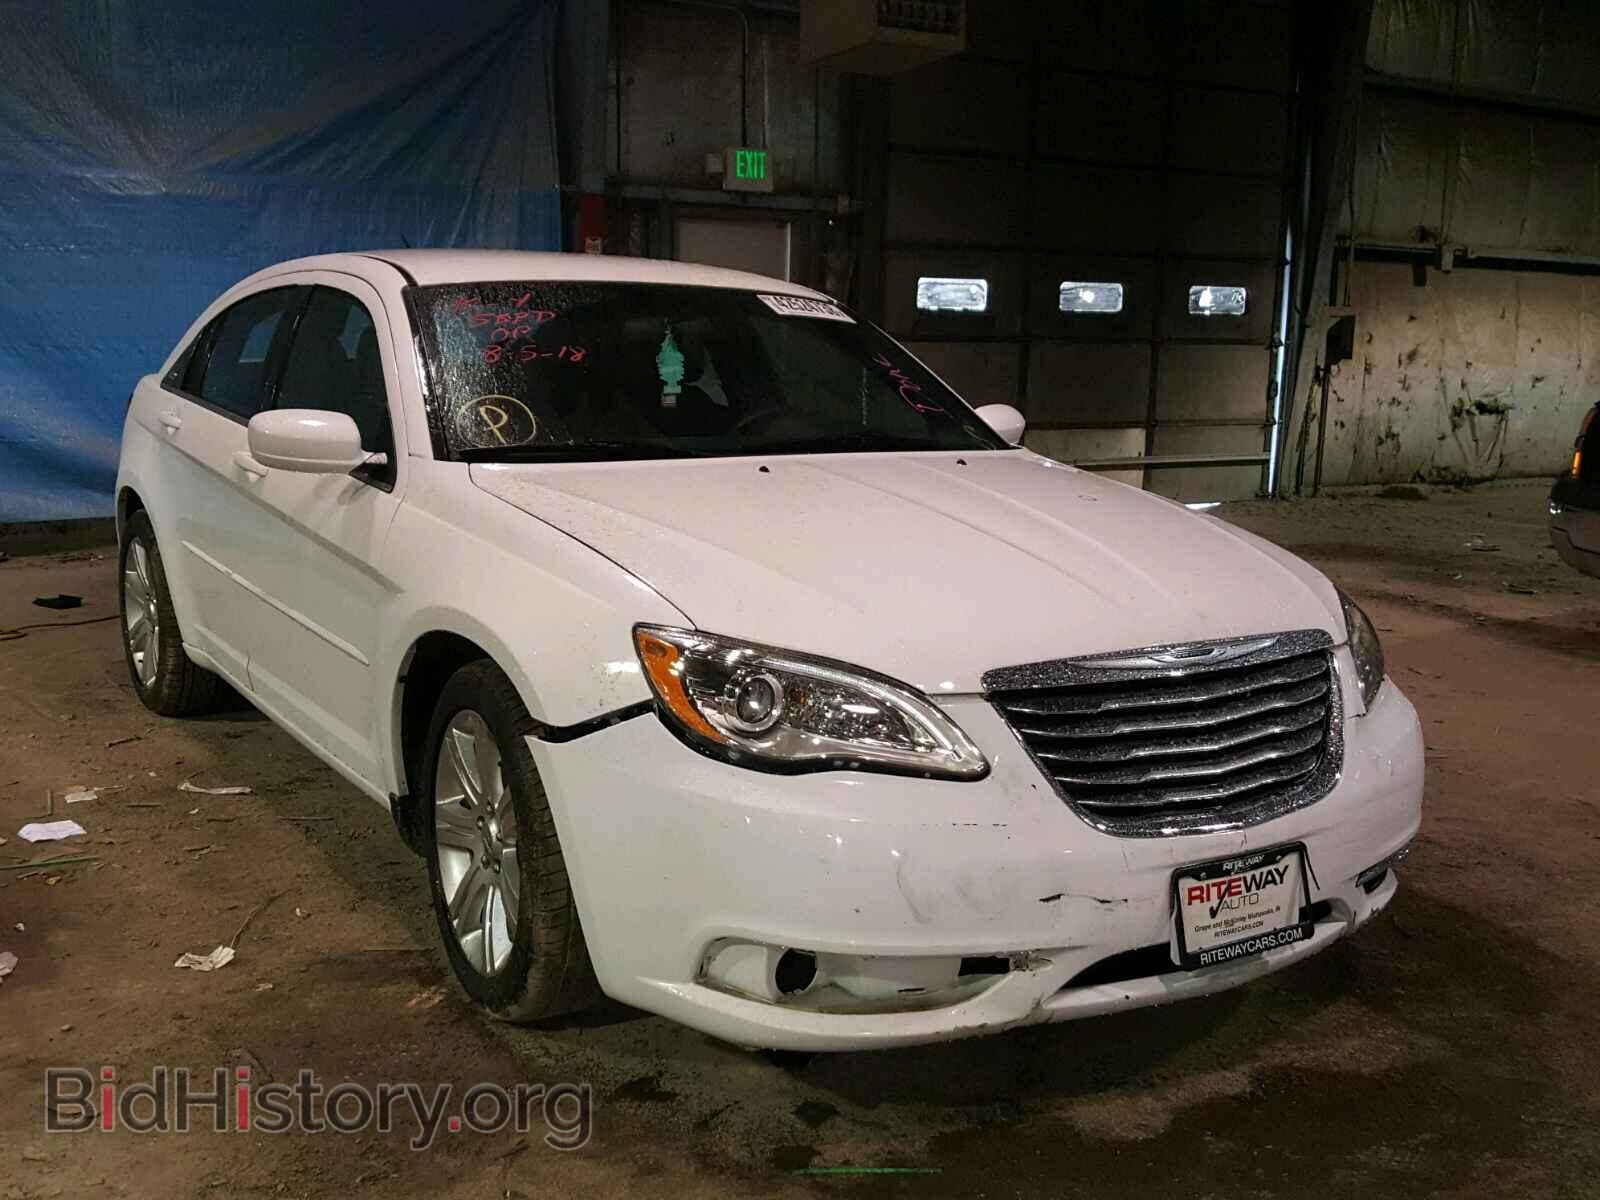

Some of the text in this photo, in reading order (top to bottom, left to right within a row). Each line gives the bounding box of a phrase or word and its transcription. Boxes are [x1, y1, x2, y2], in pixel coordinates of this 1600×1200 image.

[735, 150, 768, 179] EXIT
[1187, 864, 1289, 906] RITEWAY
[1220, 892, 1259, 912] AUTO
[1200, 927, 1303, 965] RITEWAYCARS.COM
